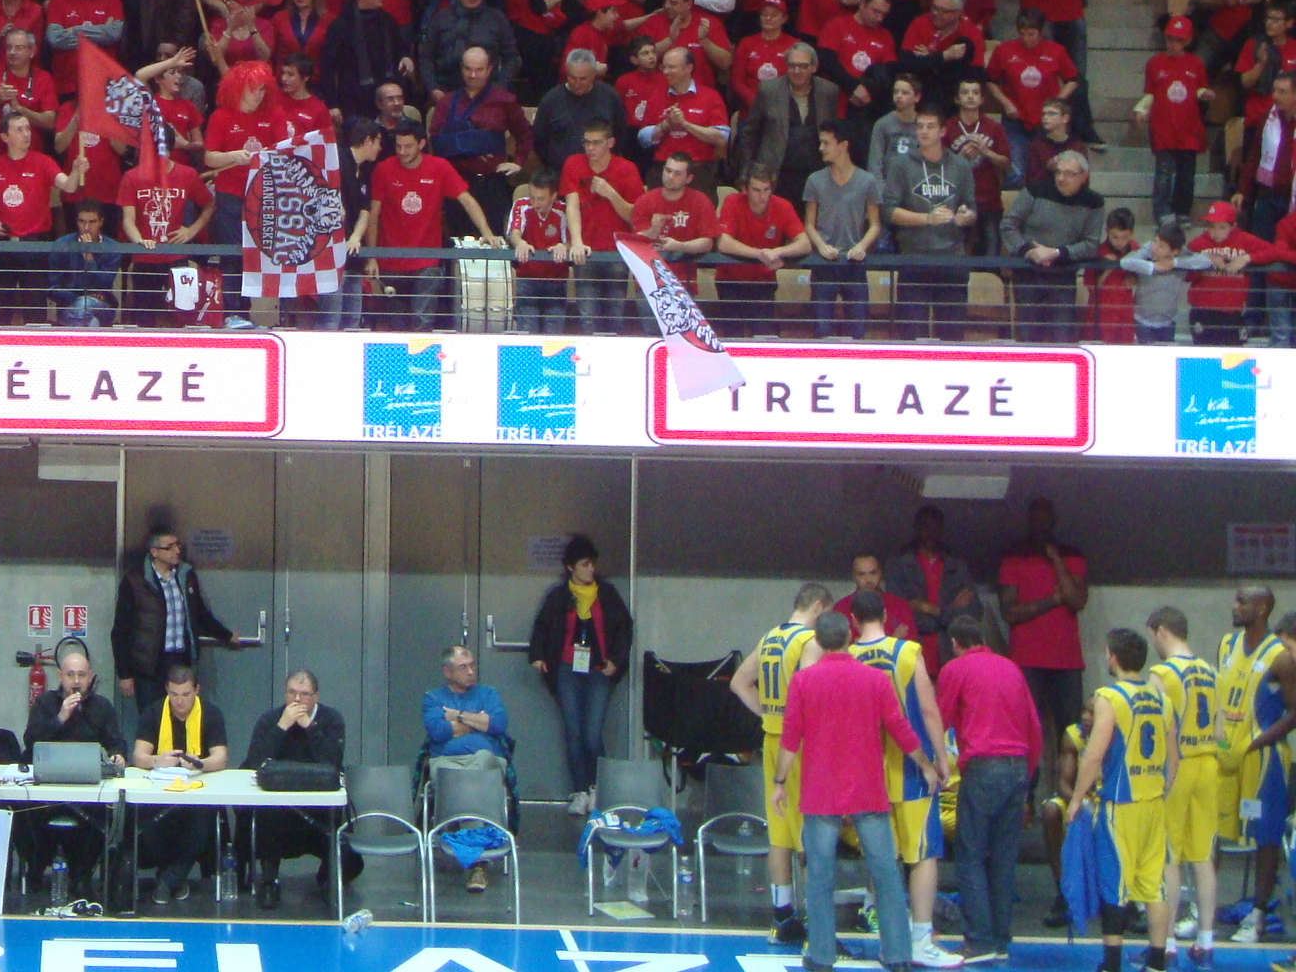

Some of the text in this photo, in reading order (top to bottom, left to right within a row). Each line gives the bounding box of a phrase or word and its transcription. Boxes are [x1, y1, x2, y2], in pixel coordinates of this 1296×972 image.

[261, 166, 275, 251] AUBANCE BASKET
[268, 153, 304, 267] BRISSAC
[362, 420, 442, 439] TRÉLAZÉ
[496, 425, 576, 441] TRÉLAZÉ
[1175, 436, 1257, 454] TRÉLAZÉ
